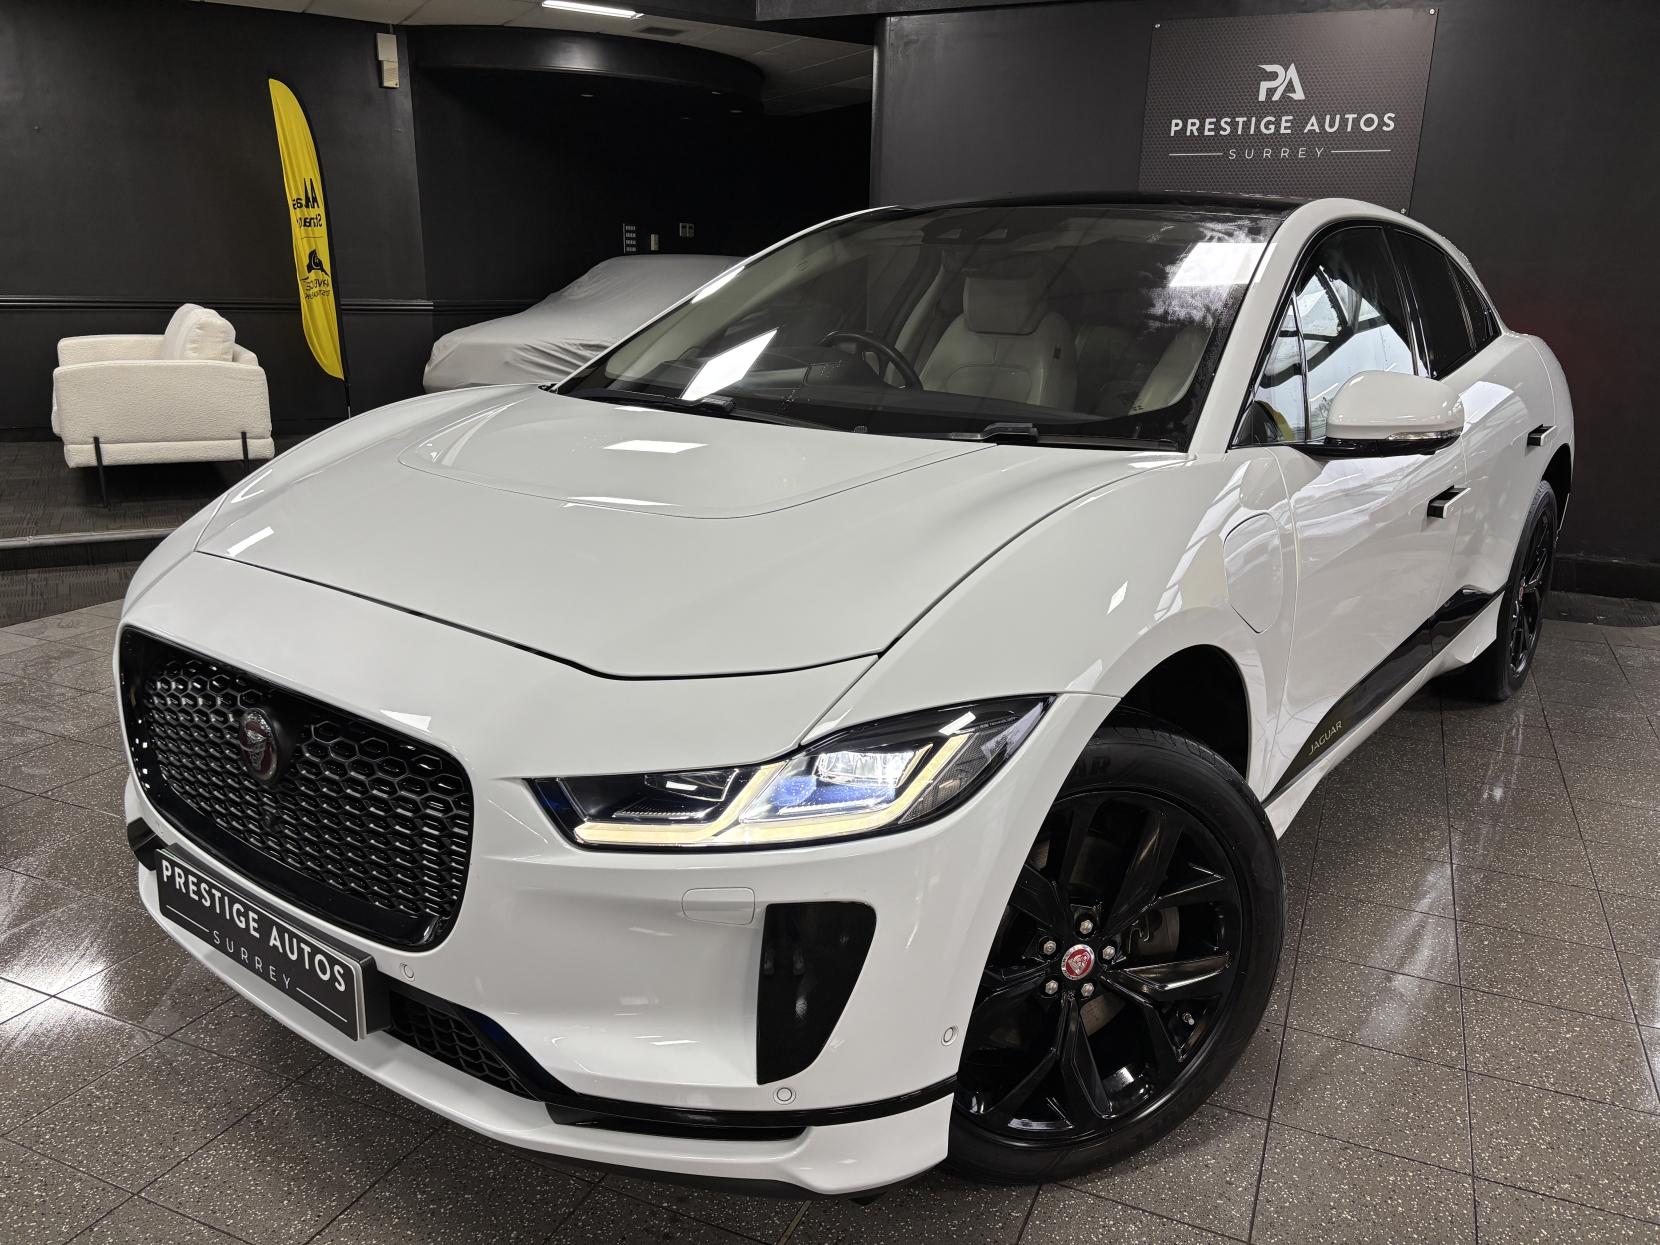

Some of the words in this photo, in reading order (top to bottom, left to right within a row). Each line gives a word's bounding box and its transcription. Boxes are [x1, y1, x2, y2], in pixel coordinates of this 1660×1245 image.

[1170, 115, 1294, 137] PRESTIGE
[1303, 112, 1396, 133] AUTOS
[1228, 146, 1325, 160] SURREY
[1308, 720, 1342, 756] JAGUAR
[161, 859, 260, 939] PRESTIGE
[269, 925, 346, 992] AUTOS
[213, 930, 292, 990] SURREY
